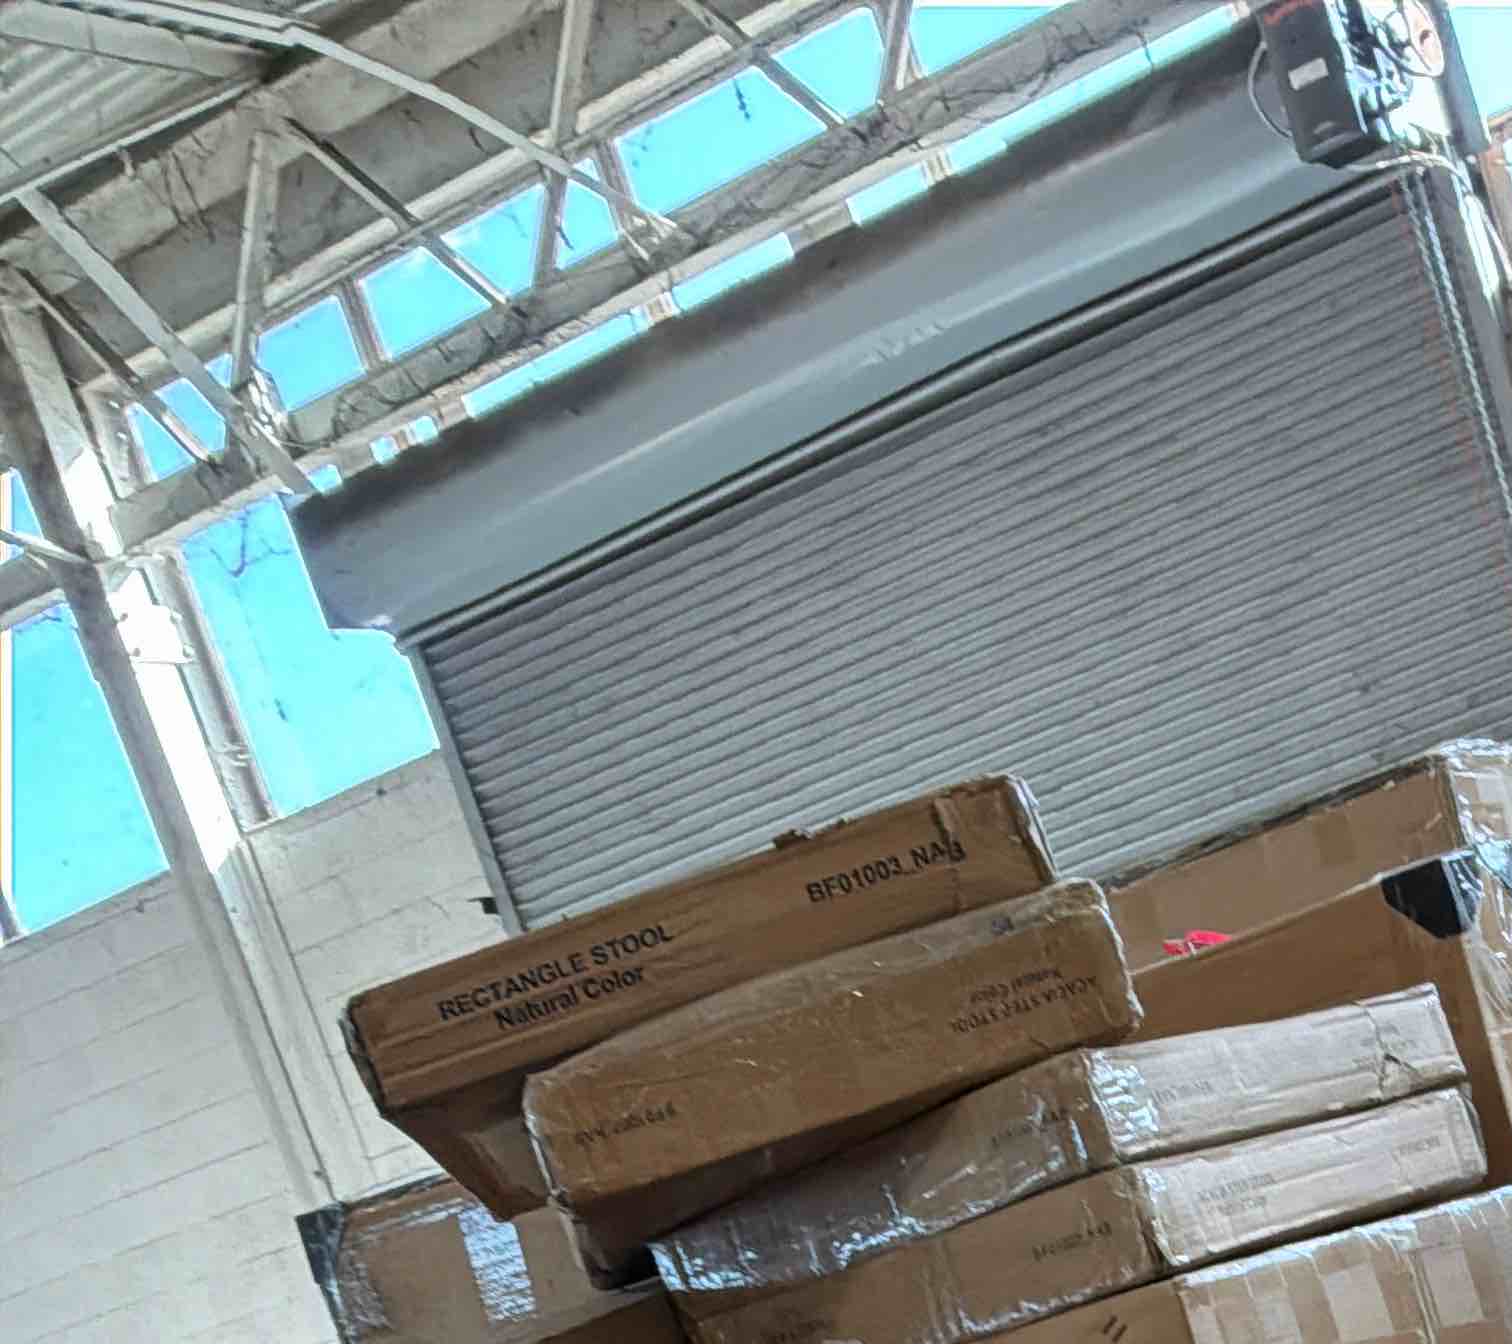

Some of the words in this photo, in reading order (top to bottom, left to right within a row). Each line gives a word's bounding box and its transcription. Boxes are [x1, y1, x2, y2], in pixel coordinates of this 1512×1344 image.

[438, 948, 586, 1021] RECTANGLE
[590, 923, 674, 976] STOOL
[578, 963, 646, 1009] Color
